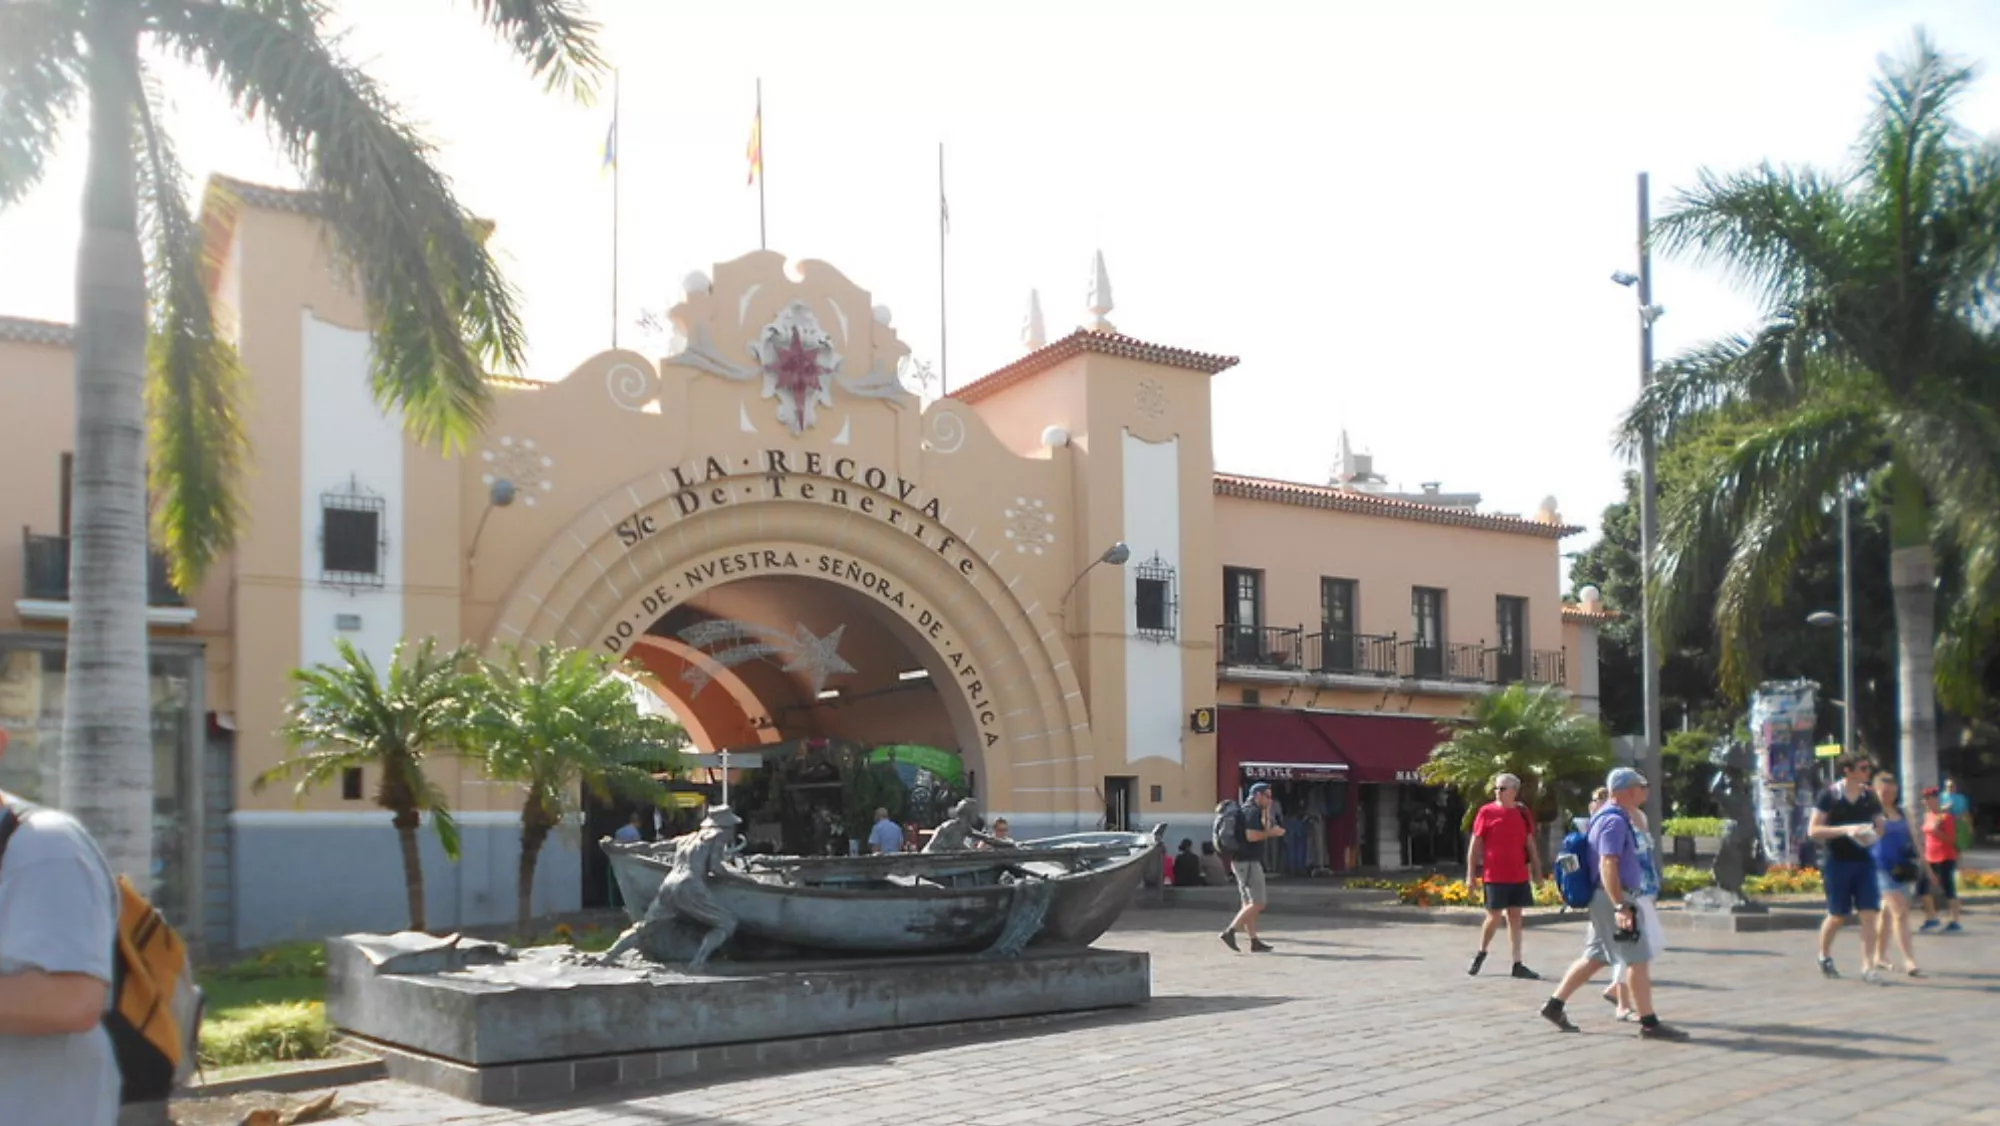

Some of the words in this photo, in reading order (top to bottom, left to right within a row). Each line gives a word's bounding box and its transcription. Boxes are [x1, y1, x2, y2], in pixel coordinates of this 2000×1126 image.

[616, 513, 657, 547] S/c
[674, 487, 727, 516] De
[766, 475, 973, 575] Tenerife
[670, 455, 727, 488] LA
[766, 449, 939, 520] RECOVA
[604, 621, 633, 653] DO
[642, 585, 673, 615] DE
[684, 550, 798, 588] NVESTRA
[819, 555, 905, 608] SEÑORA
[918, 610, 943, 638] DE
[948, 652, 999, 747] AFRICA
